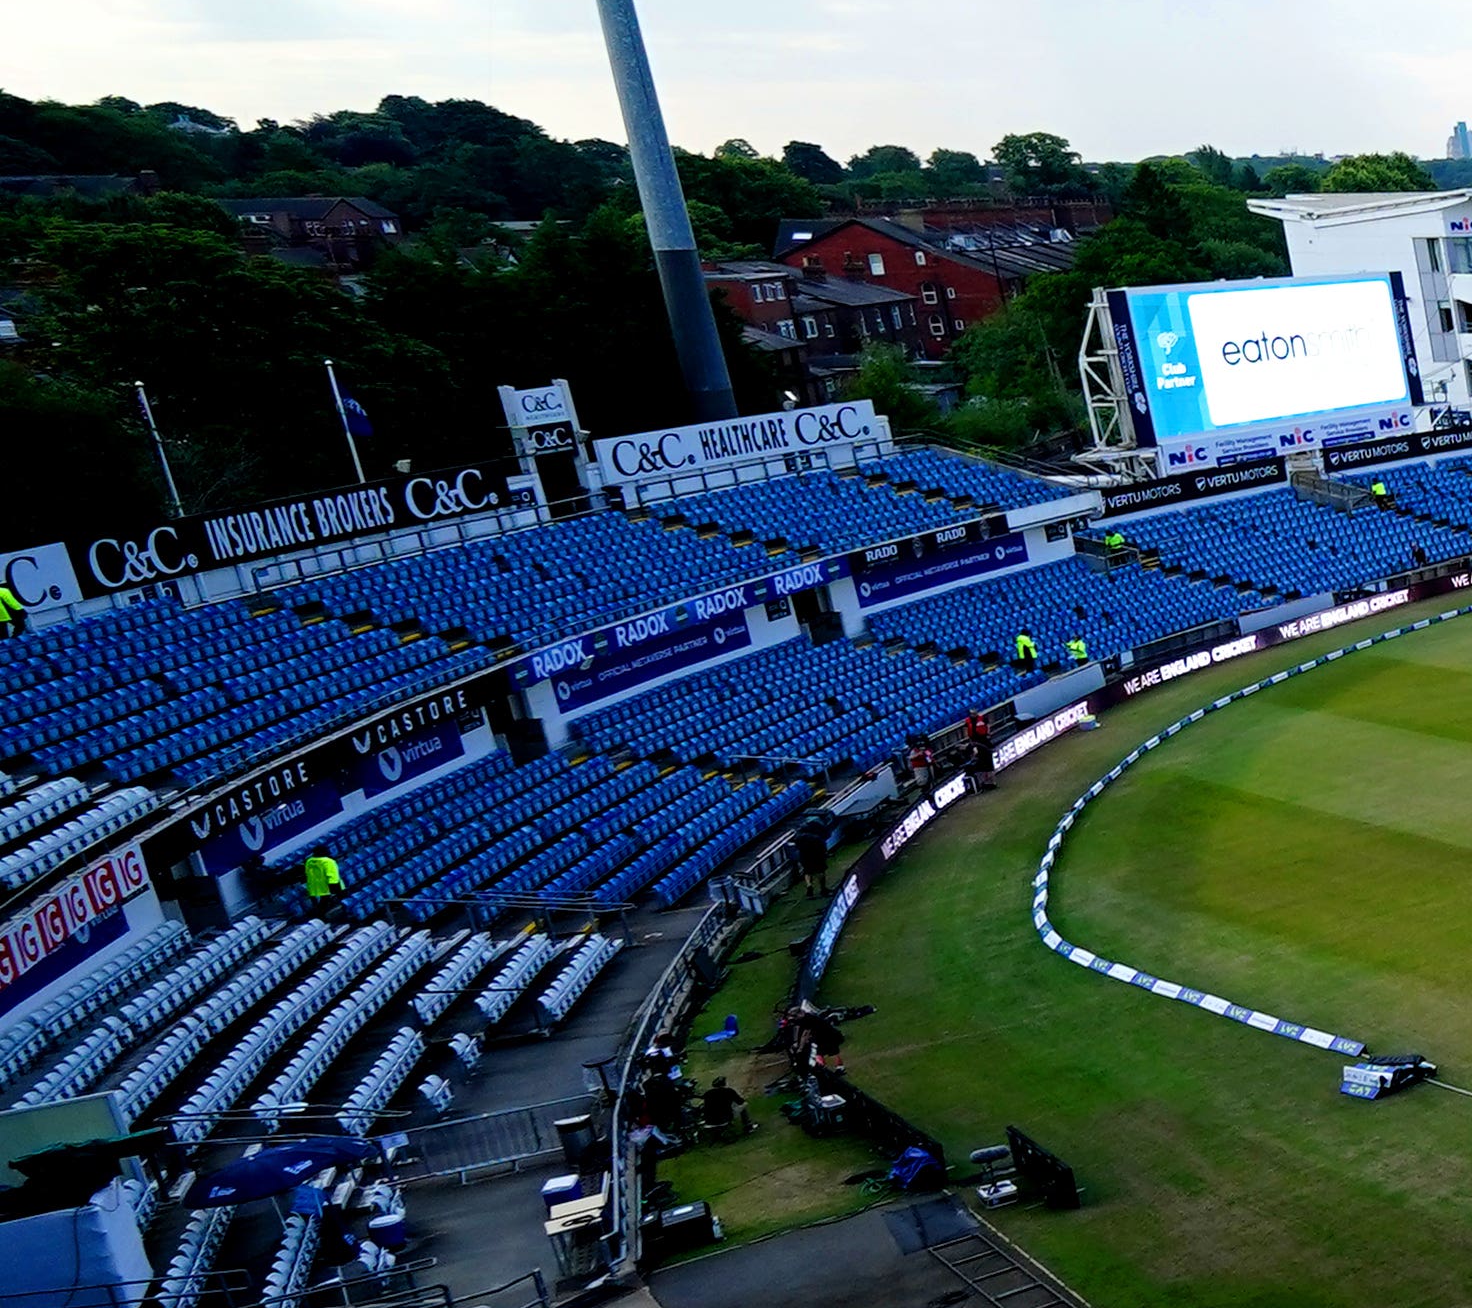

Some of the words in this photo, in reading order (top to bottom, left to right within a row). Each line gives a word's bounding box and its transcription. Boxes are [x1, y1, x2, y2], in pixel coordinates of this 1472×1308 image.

[1157, 374, 1196, 390] Partner
[1161, 363, 1187, 376] Club
[699, 418, 789, 461] HEALTHCARE
[1340, 449, 1372, 463] VERTU
[1372, 441, 1409, 458] MOTORS
[1431, 433, 1462, 448] VERTU
[1207, 473, 1240, 488] VERTU
[1240, 465, 1279, 484] MOTORS
[204, 502, 315, 561] INSURANCE
[313, 487, 394, 536] BROKERS
[936, 527, 966, 543] RADO
[866, 545, 898, 562] RADO
[773, 564, 824, 595] RADOX
[1451, 574, 1470, 589] WE
[695, 587, 747, 620] RADOX
[1280, 623, 1300, 639] WE
[1301, 616, 1321, 634] ARE
[1321, 599, 1369, 630] ENGLAND
[1370, 589, 1410, 613] CRICKET
[615, 612, 670, 647] RADOX
[533, 640, 588, 678] RADOX
[1124, 676, 1142, 695] WE
[1140, 668, 1161, 689] ARE
[1160, 652, 1211, 681] ENGLAND
[1210, 635, 1258, 663] CRICKET
[376, 691, 468, 744] CASTORE
[402, 736, 443, 763] virtua
[216, 762, 309, 825] CASTORE
[262, 800, 305, 829] virtua
